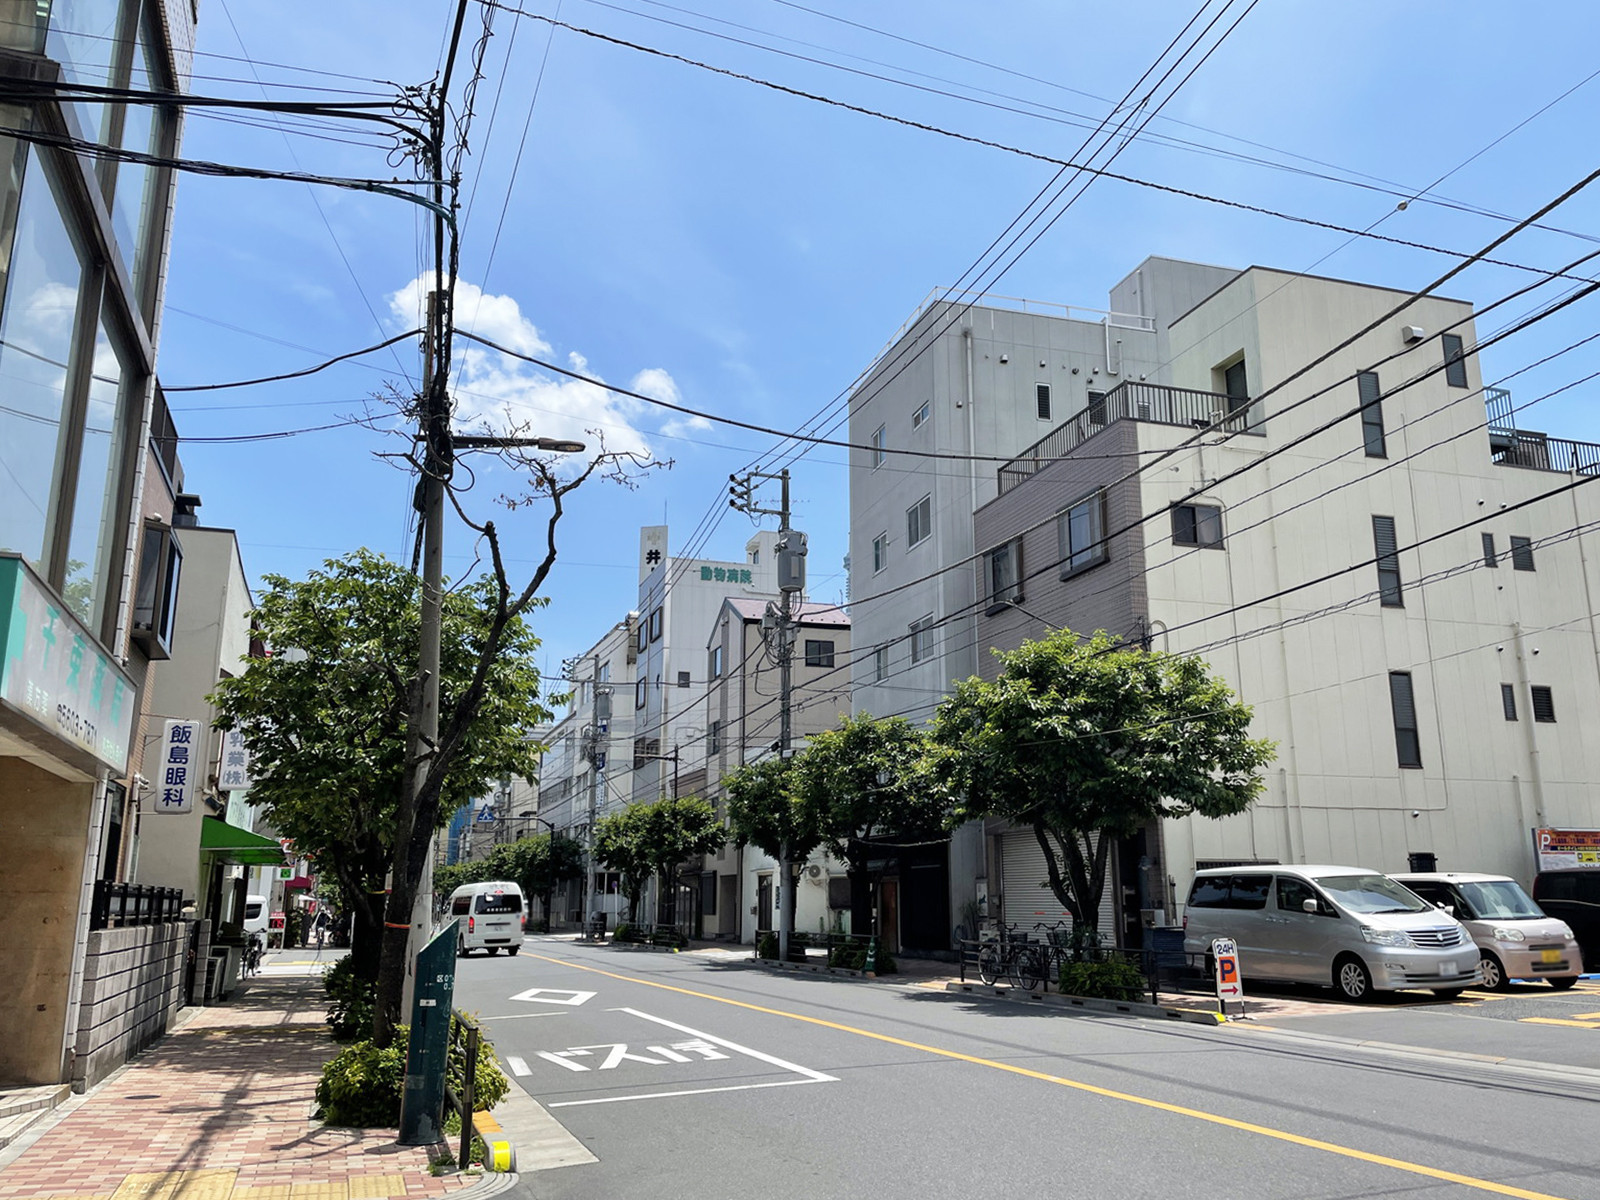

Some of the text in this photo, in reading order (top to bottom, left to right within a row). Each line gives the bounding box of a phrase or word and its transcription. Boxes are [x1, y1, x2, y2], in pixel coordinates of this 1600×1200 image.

[700, 566, 752, 584] 動物病院
[162, 725, 192, 807] 飯島眼科
[1541, 833, 1551, 850] P
[1216, 943, 1235, 955] 24H
[1219, 958, 1236, 982] P
[505, 1038, 732, 1077] バス停
